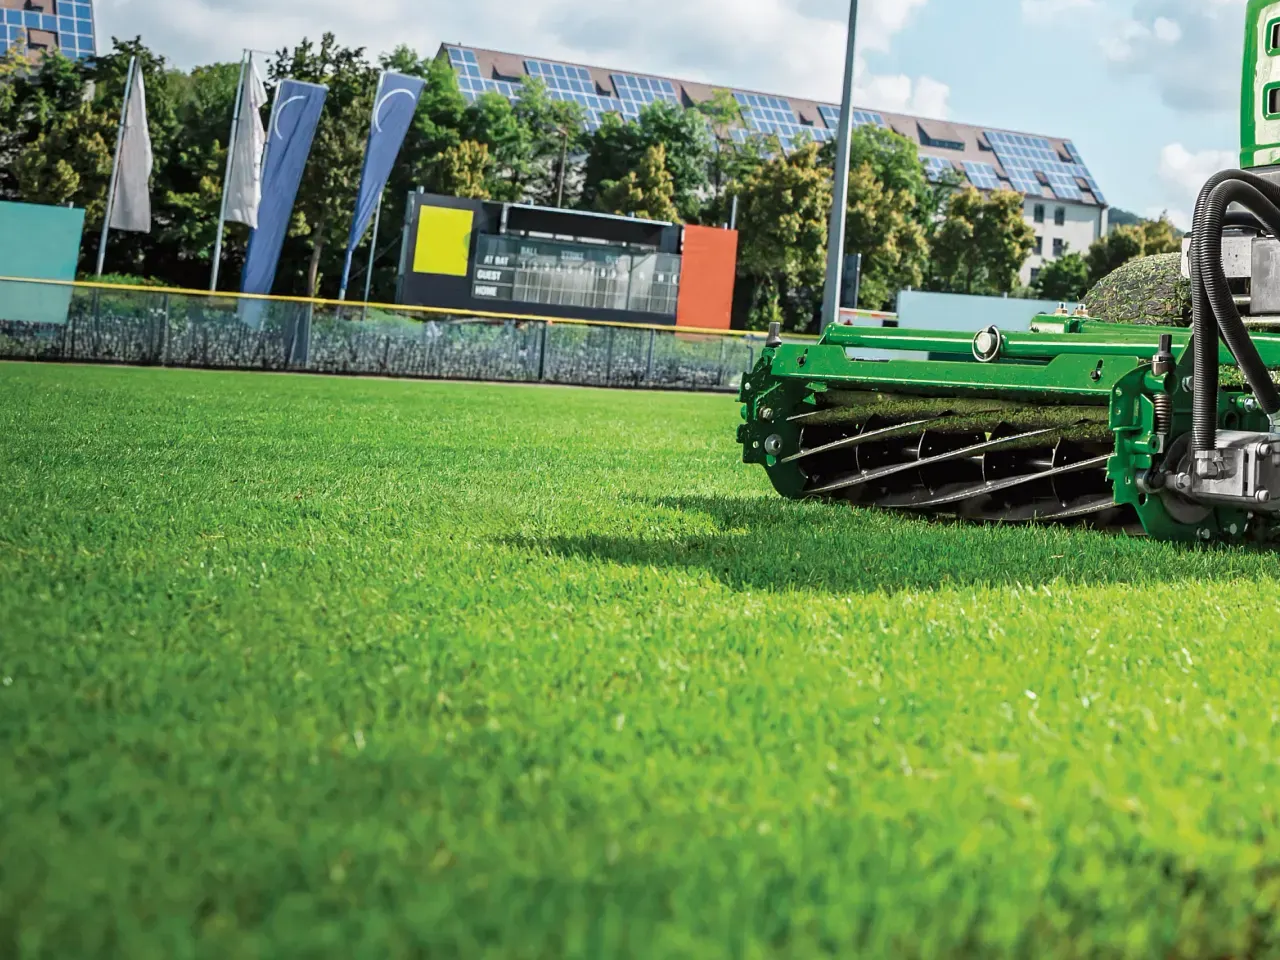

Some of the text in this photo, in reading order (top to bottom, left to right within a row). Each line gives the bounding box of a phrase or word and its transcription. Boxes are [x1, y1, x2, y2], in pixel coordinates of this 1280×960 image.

[483, 254, 509, 266] AT BAT
[476, 269, 502, 281] GUEST
[474, 285, 498, 297] HOME
